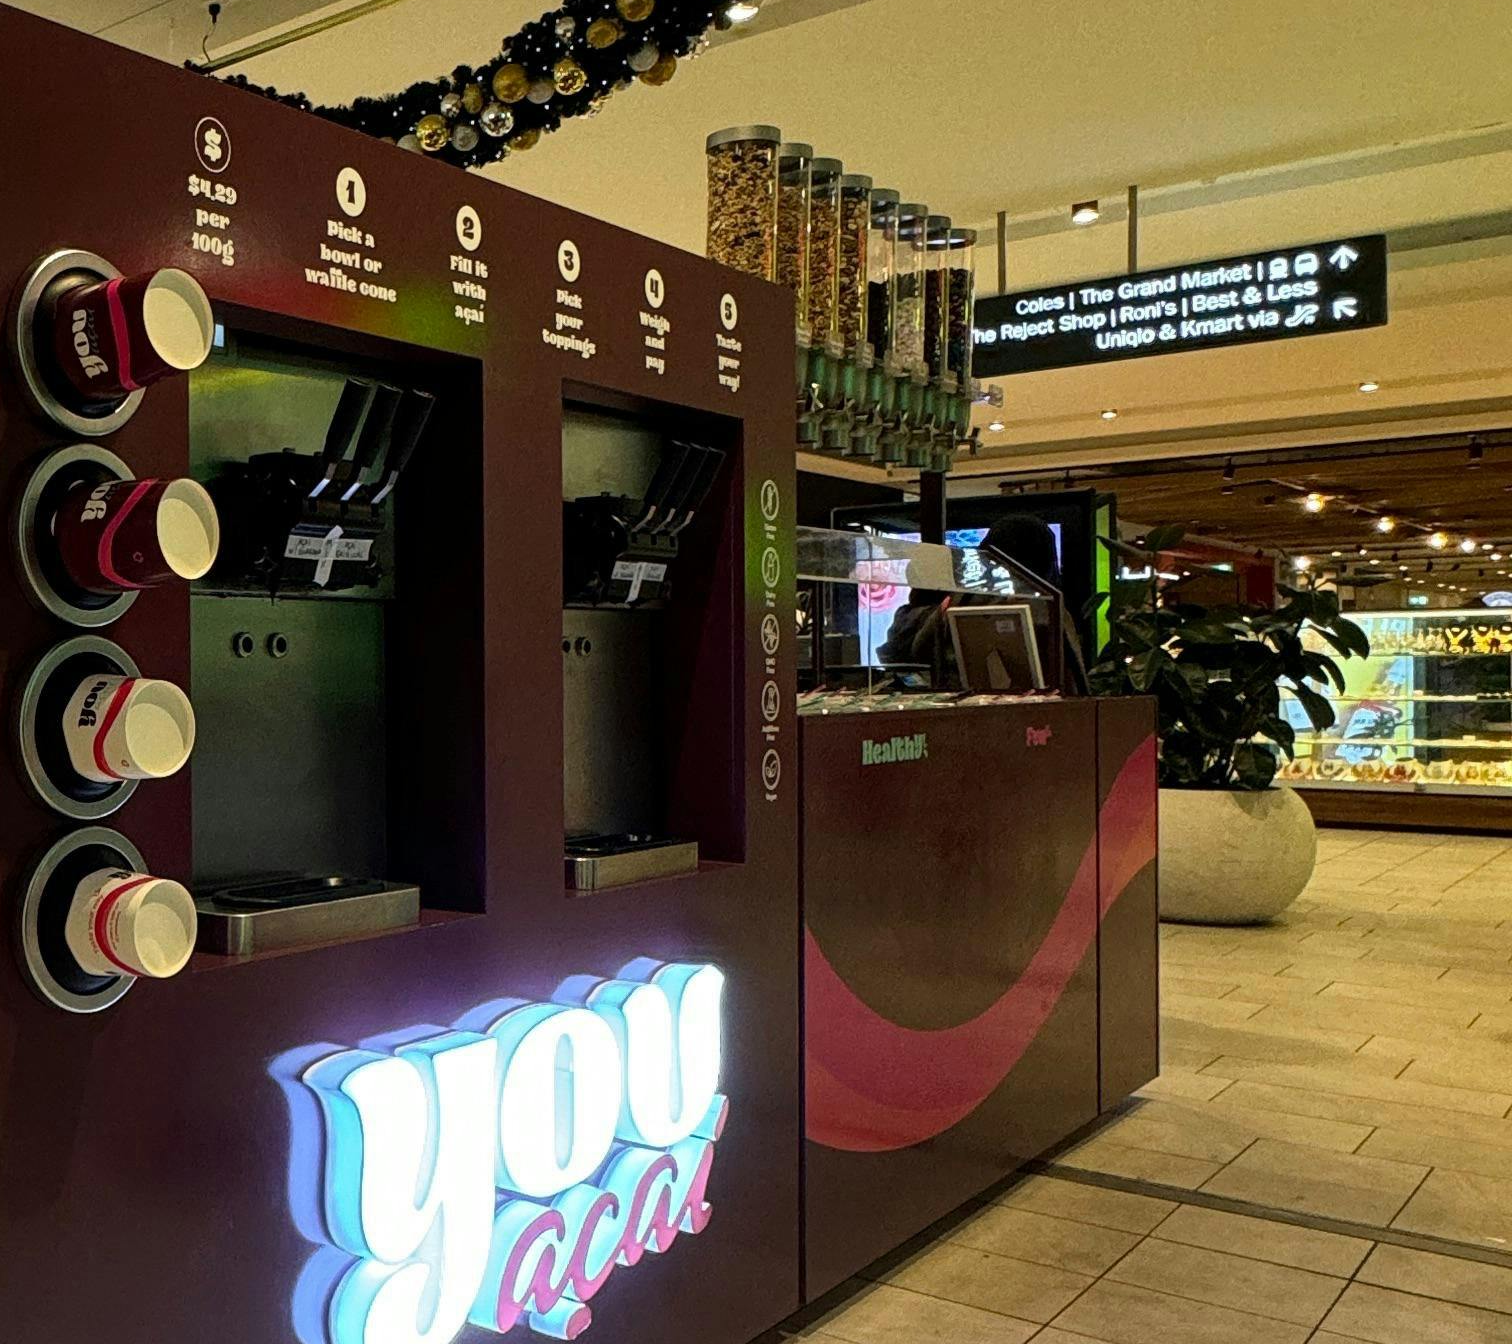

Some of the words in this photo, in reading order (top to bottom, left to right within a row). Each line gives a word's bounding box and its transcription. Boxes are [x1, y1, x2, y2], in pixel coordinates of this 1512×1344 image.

[188, 174, 237, 205] $4.29
[345, 180, 356, 205] 1
[195, 208, 230, 230] per
[462, 216, 474, 240] 2
[191, 232, 235, 267] 100g
[366, 233, 376, 248] a
[320, 243, 361, 269] bowl
[364, 257, 382, 274] or
[450, 254, 473, 275] Fill
[475, 260, 488, 279] it
[563, 250, 574, 272] 3
[304, 267, 357, 294] waffle
[359, 281, 397, 303] cone
[452, 281, 486, 301] with
[650, 277, 659, 298] 4
[1015, 294, 1065, 316] Coles
[1079, 287, 1114, 306] The
[1118, 275, 1176, 299] Grand
[1181, 263, 1252, 290] Market
[556, 289, 582, 309] Pick
[724, 302, 732, 320] 5
[1000, 318, 1055, 341] Reject
[1059, 312, 1106, 332] Shop
[1120, 300, 1177, 324] Roni's
[1192, 290, 1239, 312] Best
[1242, 286, 1262, 306] &
[1267, 280, 1320, 301] Less
[555, 312, 583, 330] your
[1095, 328, 1155, 350] Uniqlo
[1159, 323, 1177, 341] &
[1181, 314, 1244, 338] Kmart
[1247, 310, 1280, 329] via
[72, 309, 109, 379] you
[542, 328, 596, 359] toppings
[77, 680, 109, 729] you
